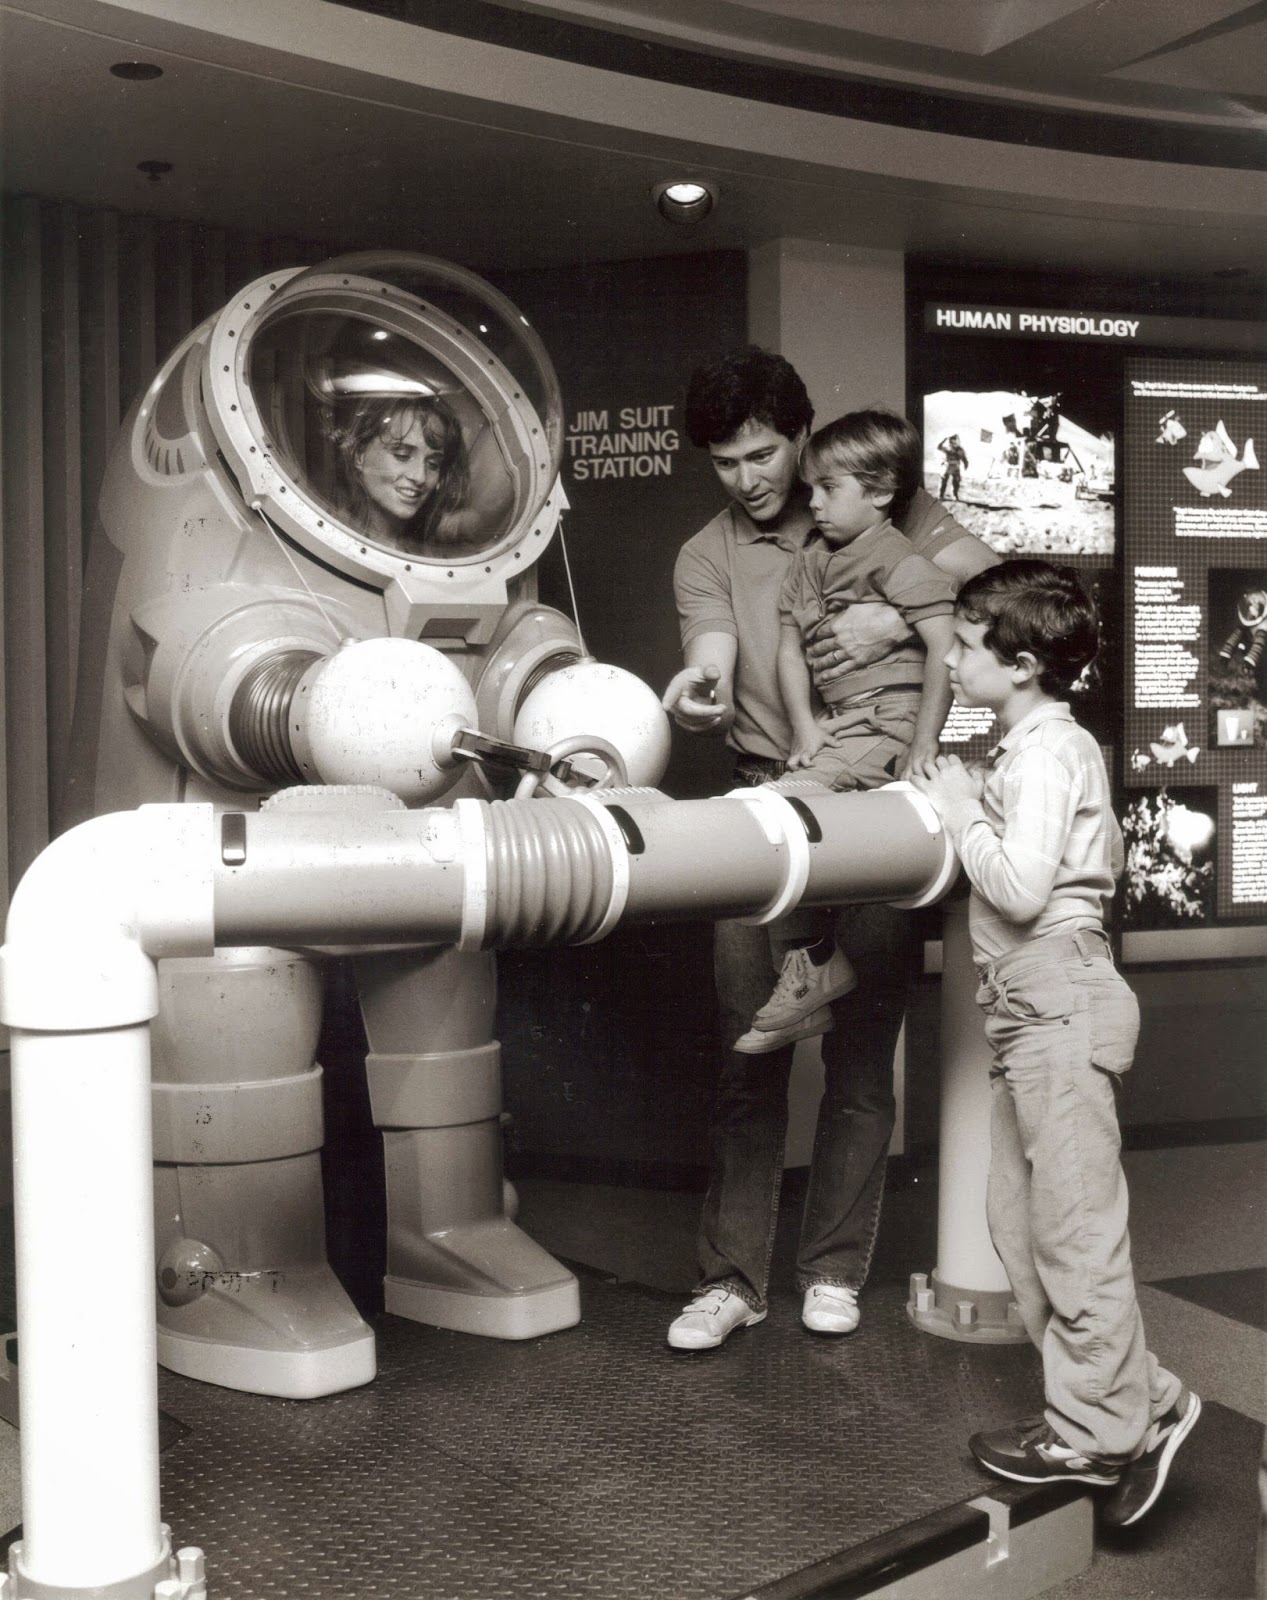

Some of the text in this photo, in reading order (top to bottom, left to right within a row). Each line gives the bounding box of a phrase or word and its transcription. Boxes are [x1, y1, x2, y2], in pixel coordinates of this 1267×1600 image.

[936, 308, 1140, 338] HUMAN PHYSIOLOGY
[569, 404, 675, 433] JIM SUIT
[565, 429, 680, 457] TRAINING
[573, 454, 672, 481] STATION
